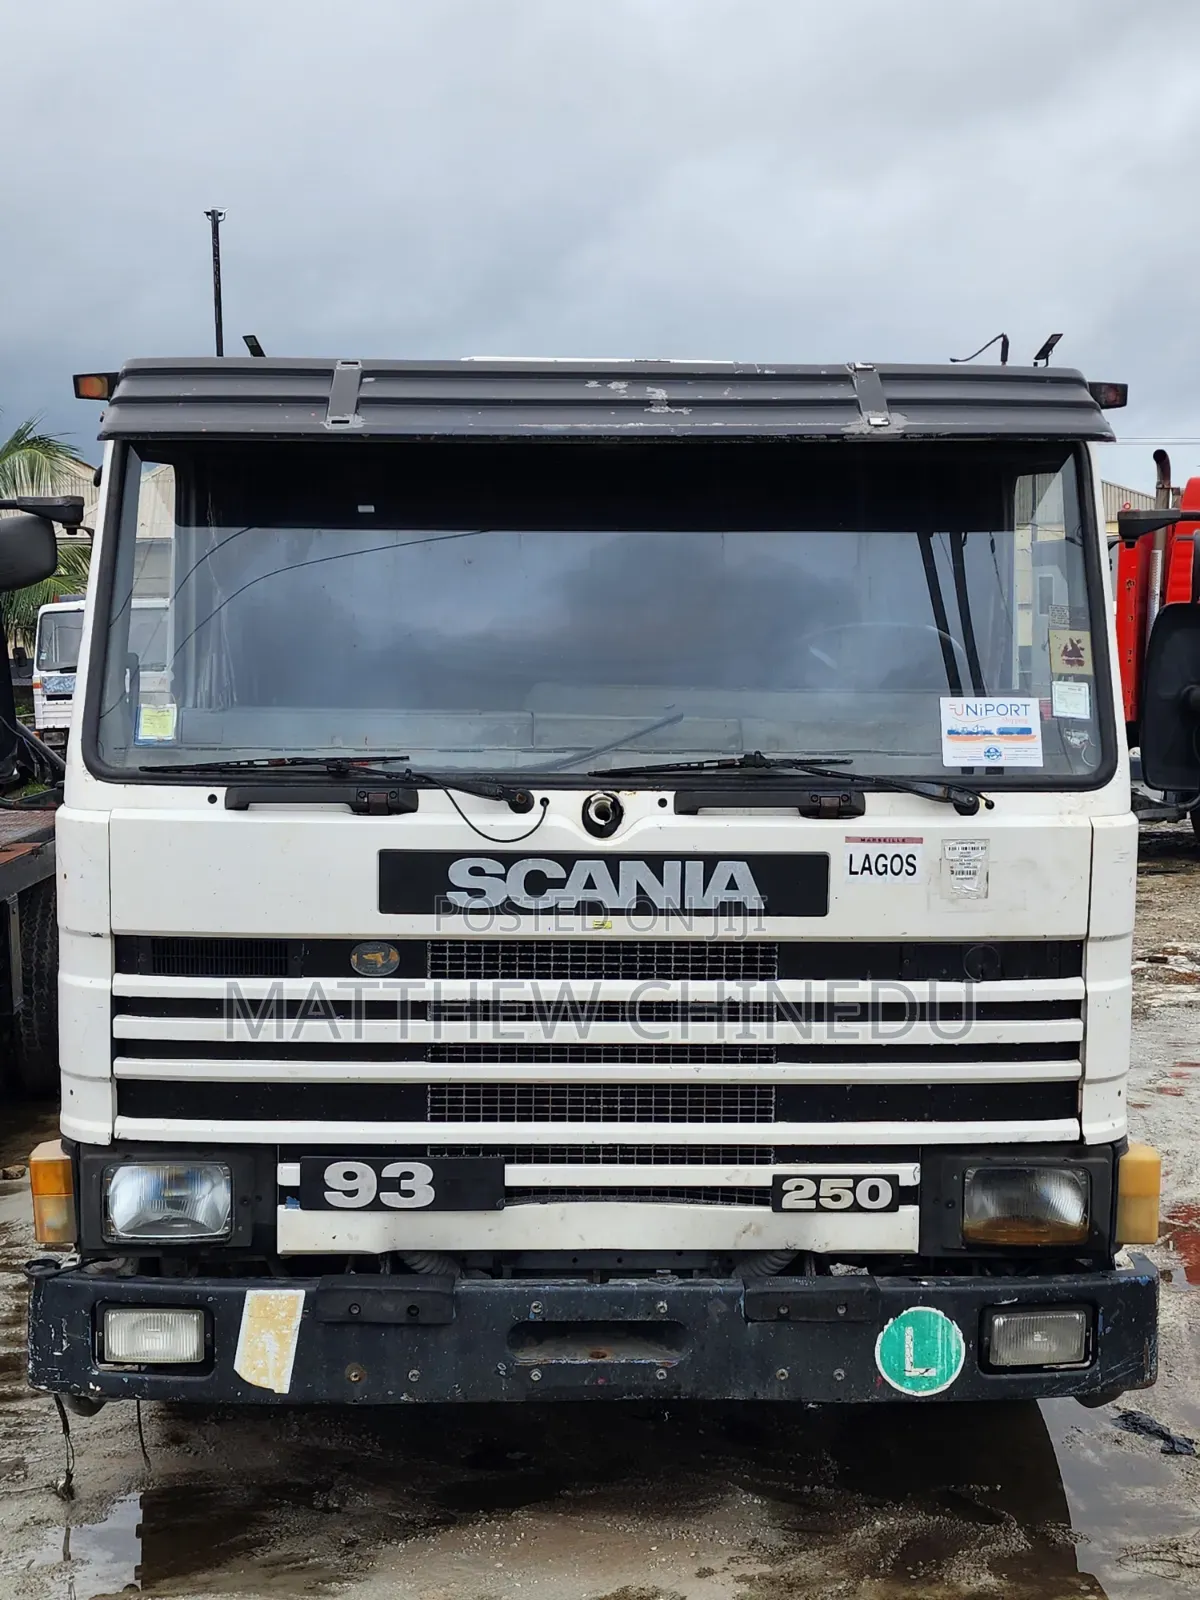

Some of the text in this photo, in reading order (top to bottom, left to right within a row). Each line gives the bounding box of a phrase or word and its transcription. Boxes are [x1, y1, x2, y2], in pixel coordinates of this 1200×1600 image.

[446, 857, 765, 910] SCANIA
[848, 853, 917, 877] LAGOS
[323, 1161, 436, 1209] 93
[781, 1177, 893, 1210] 250
[904, 1326, 937, 1377] L
